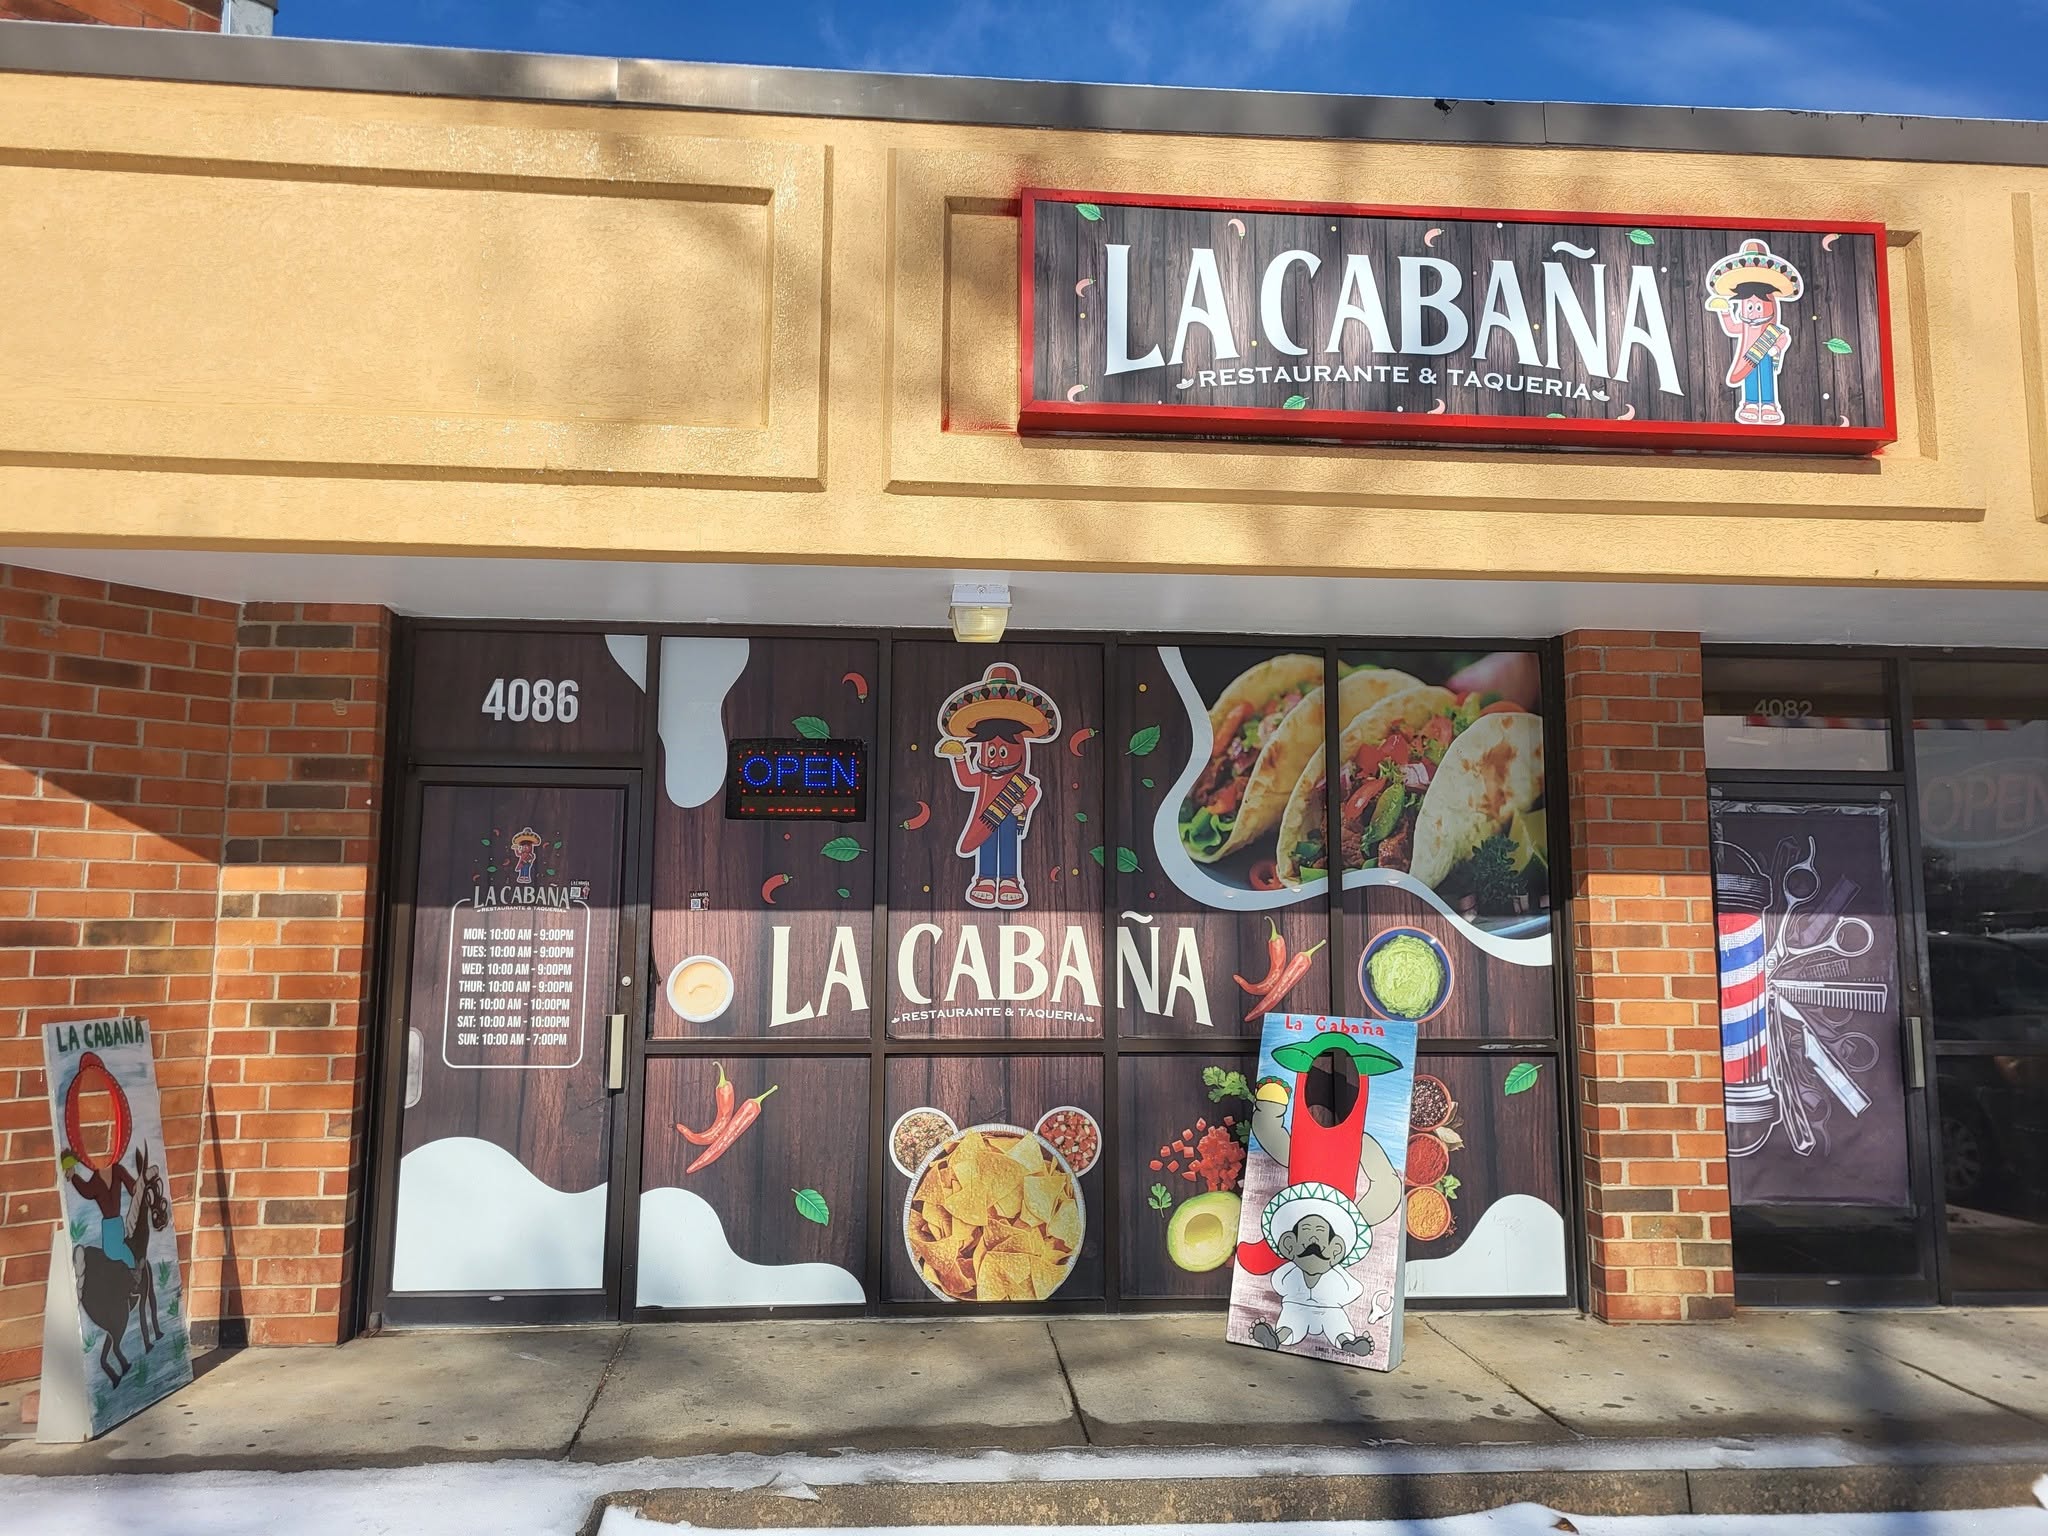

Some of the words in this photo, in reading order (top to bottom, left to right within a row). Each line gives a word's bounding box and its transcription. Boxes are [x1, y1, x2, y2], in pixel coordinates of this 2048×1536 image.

[1103, 243, 1240, 377] LA
[1260, 240, 1686, 397] CABAÑA
[1199, 364, 1410, 388] RESTAURANTE
[1419, 368, 1438, 386] &
[1447, 368, 1592, 402] TAQUERIA
[481, 678, 580, 723] 4086
[1753, 698, 1813, 720] 4082
[743, 756, 856, 788] OPEN
[473, 885, 497, 909] LA
[500, 883, 571, 910] CABAÑA
[463, 928, 487, 940] MON:
[489, 928, 516, 940] 10:00
[517, 929, 532, 940] AM
[539, 929, 574, 941] 9:00PM
[461, 945, 487, 957] TUES:
[489, 946, 516, 957] 10:00
[517, 946, 532, 957] AM
[539, 946, 574, 958] 9:00PM
[461, 963, 485, 975] WED:
[487, 963, 514, 975] 10:00
[514, 963, 530, 975] AM
[537, 963, 572, 975] 9:00PM
[770, 925, 870, 1028] LA
[896, 910, 1215, 1027] CABAÑA
[458, 980, 486, 993] THUR:
[488, 980, 514, 993] 10:00
[515, 981, 531, 993] AM
[538, 981, 573, 993] 9:00PM
[459, 998, 477, 1010] FRI:
[479, 998, 505, 1010] 10:00
[506, 998, 522, 1010] AM
[530, 998, 570, 1010] 10:00PM
[901, 1007, 1001, 1022] RESTAURANTE
[1004, 1007, 1015, 1017] &
[1018, 1007, 1087, 1023] TAQUERIA
[457, 1015, 476, 1028] SAT:
[479, 1015, 505, 1028] 10:00
[506, 1016, 521, 1028] AM
[530, 1016, 570, 1028] 10:00PM
[1285, 1015, 1302, 1031] La
[1315, 1016, 1385, 1037] Cabaña
[56, 1024, 81, 1053] LA
[83, 1016, 145, 1049] CABAÑA
[457, 1033, 480, 1045] SUN:
[481, 1033, 508, 1045] 10:00
[509, 1033, 525, 1045] AM
[532, 1033, 567, 1046] 7:00PM
